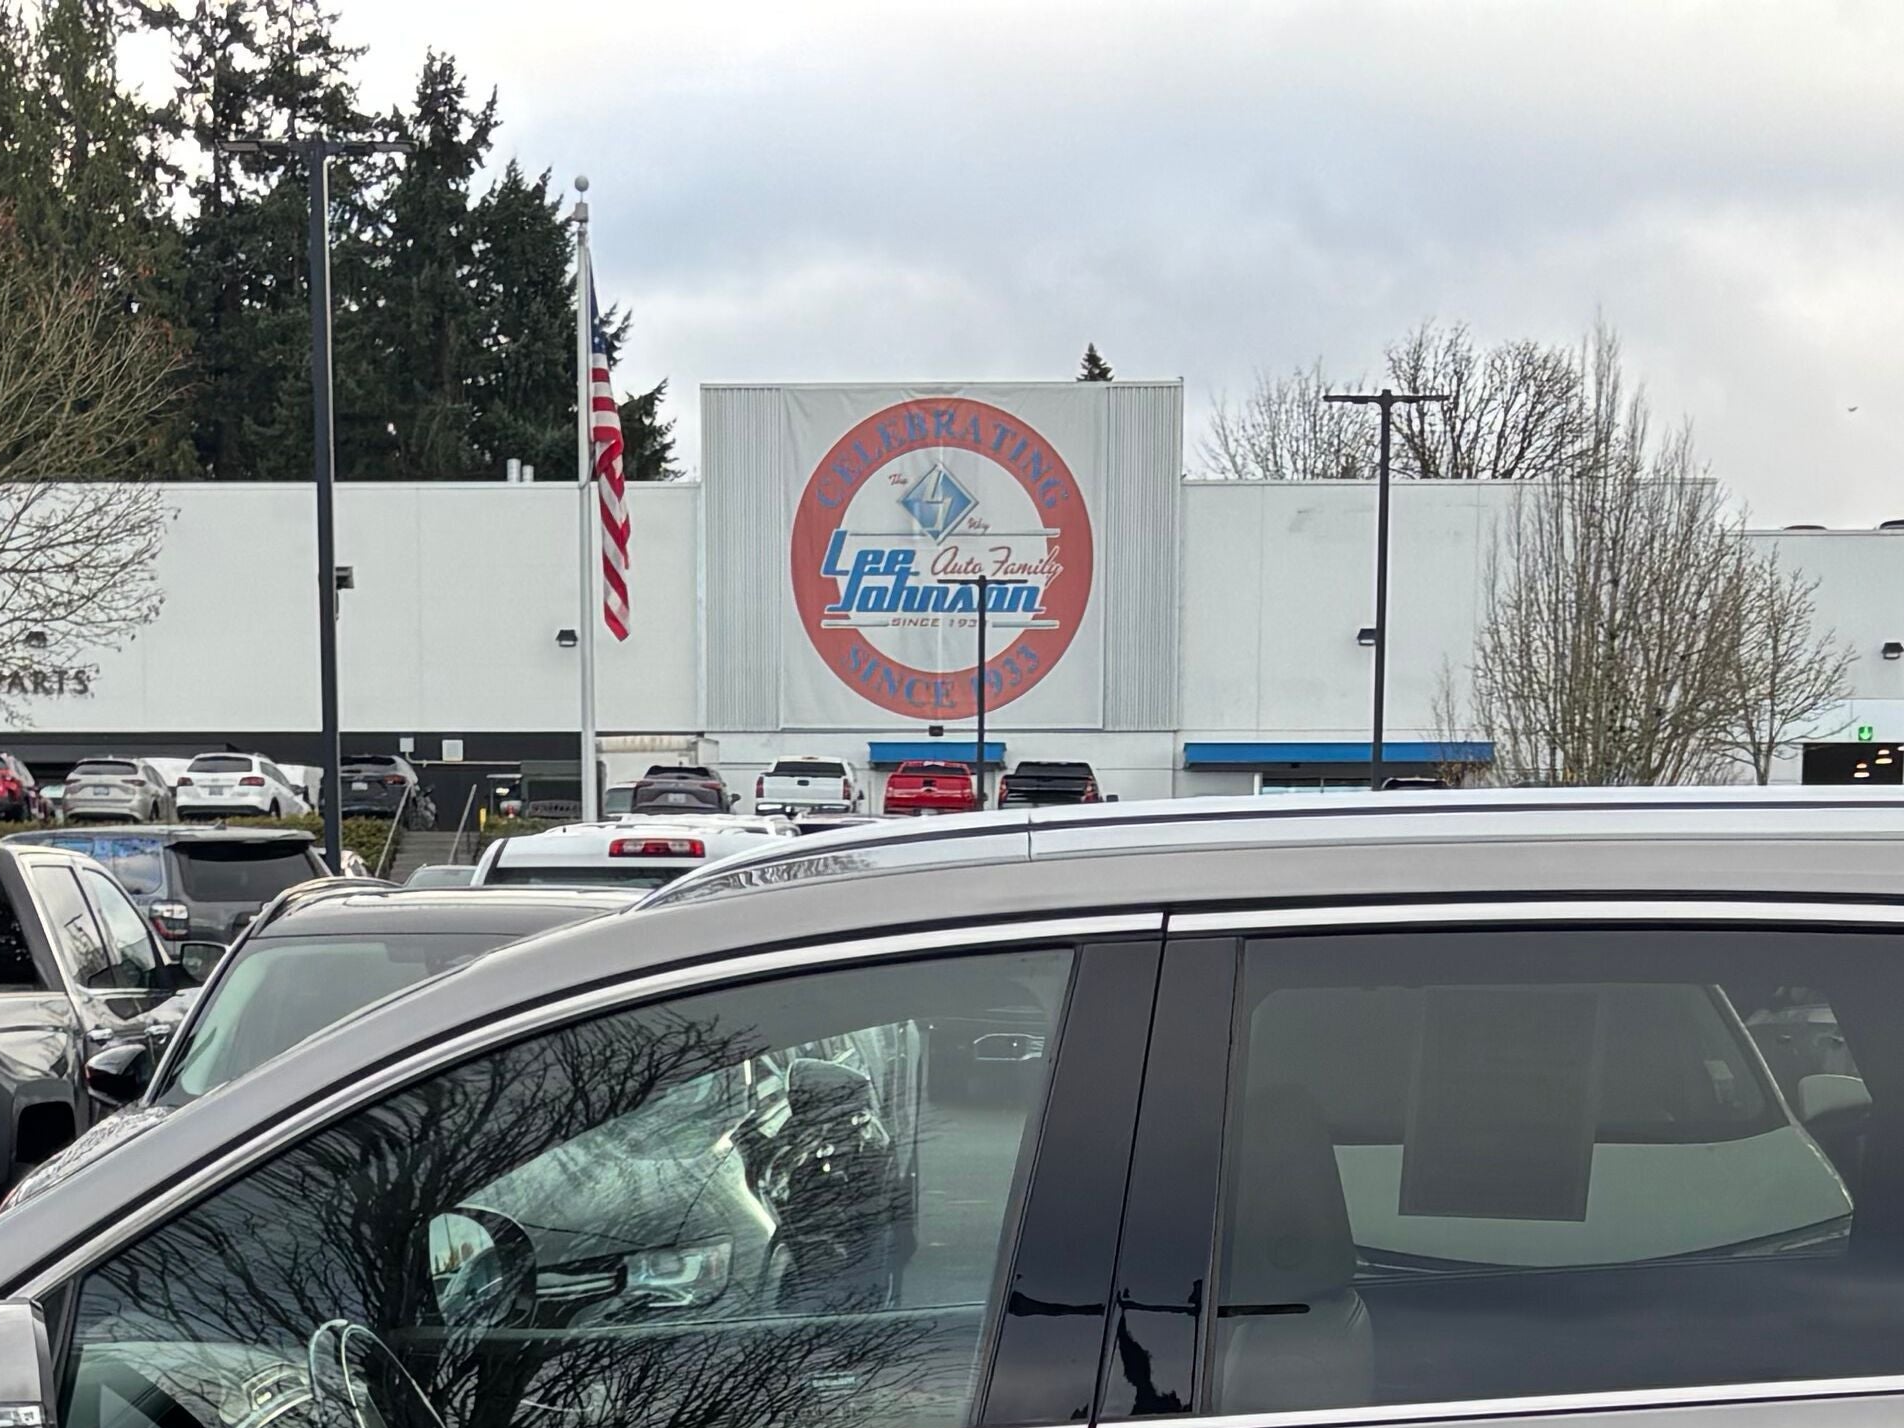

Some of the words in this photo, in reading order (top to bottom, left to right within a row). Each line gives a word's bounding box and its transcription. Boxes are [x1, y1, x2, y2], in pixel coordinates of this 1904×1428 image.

[816, 409, 1070, 510] CELEBRATING
[822, 530, 920, 577] Lee
[930, 545, 984, 576] Auto
[988, 545, 1064, 588] Family
[826, 568, 1046, 614] Johnson
[891, 617, 940, 628] SINCE
[949, 617, 989, 629] 193
[842, 644, 956, 709] SINCE
